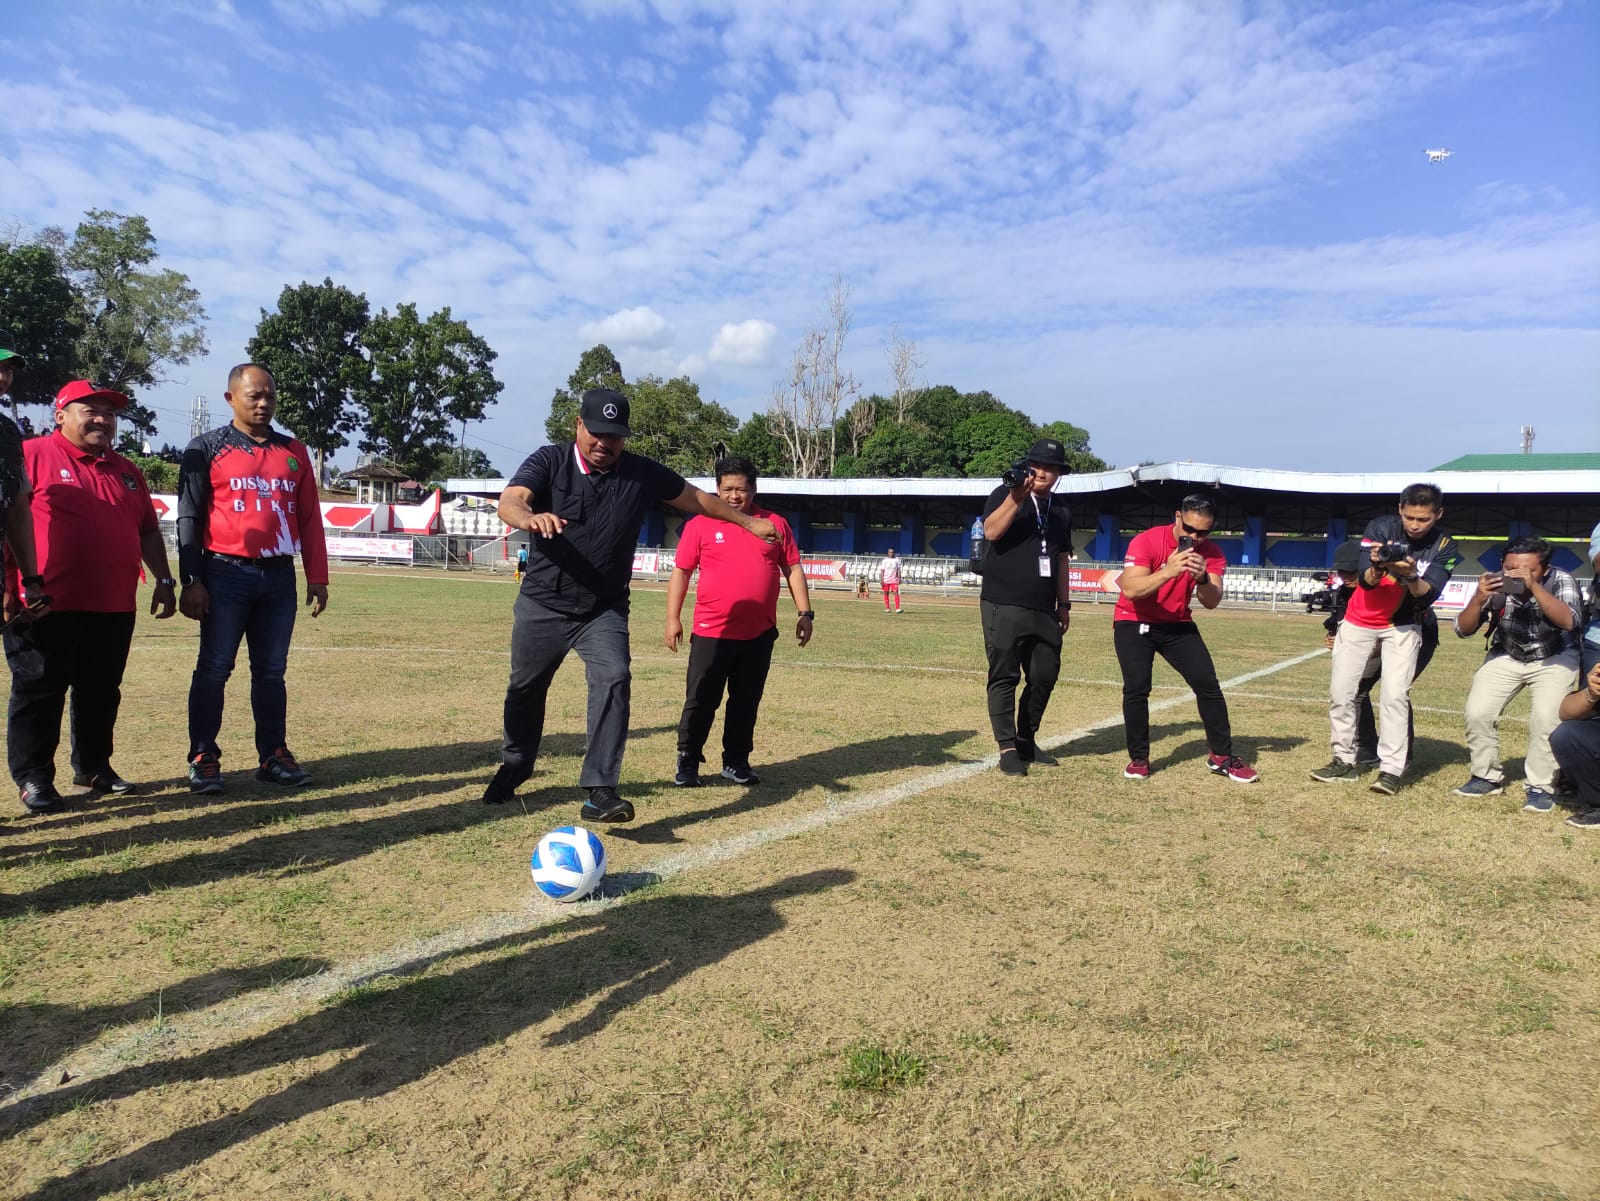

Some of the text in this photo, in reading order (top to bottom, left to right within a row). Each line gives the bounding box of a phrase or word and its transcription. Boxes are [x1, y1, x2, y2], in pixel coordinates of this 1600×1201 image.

[234, 499, 296, 514] BIKE
[1069, 571, 1082, 580] SSI
[1069, 580, 1102, 589] ANEGARA
